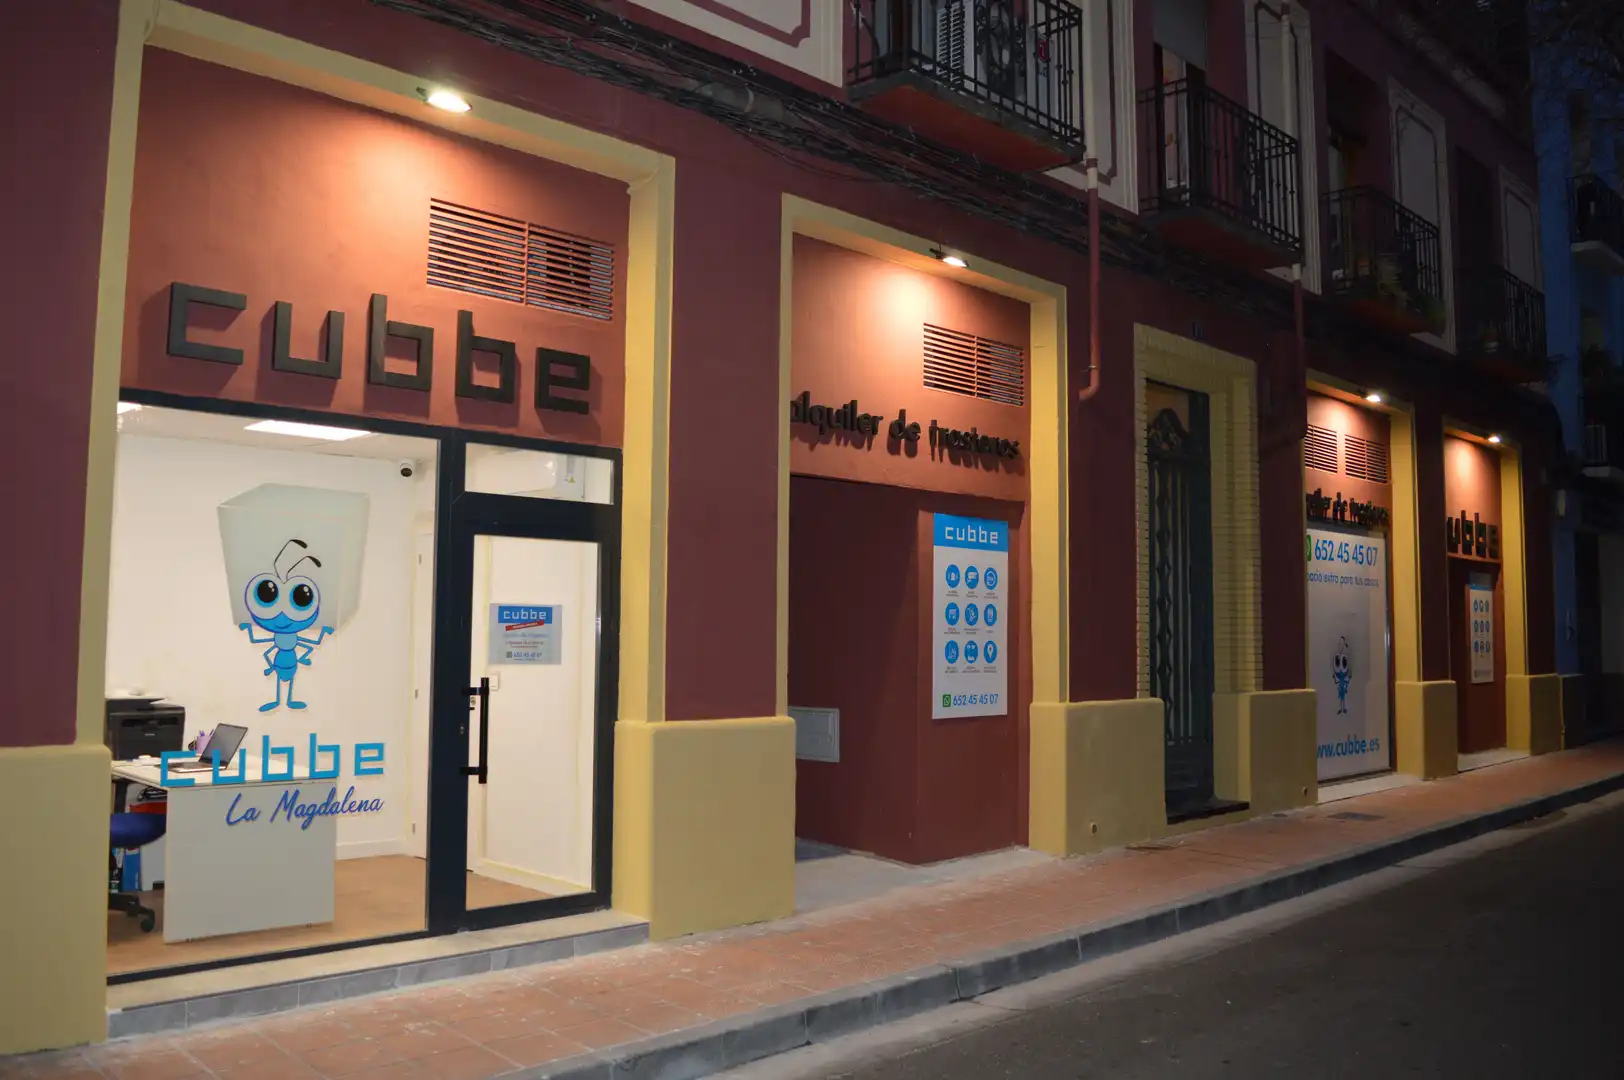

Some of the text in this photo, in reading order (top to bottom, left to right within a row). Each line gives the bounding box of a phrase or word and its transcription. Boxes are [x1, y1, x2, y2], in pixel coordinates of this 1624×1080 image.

[166, 281, 591, 414] cubbe
[790, 390, 1020, 459] alquiler de trasteros
[945, 525, 998, 544] cubbe
[1447, 509, 1499, 551] ubbe
[1315, 539, 1378, 566] 652 45 45 07
[503, 608, 547, 620] cubbe
[953, 693, 998, 706] 652 45 45 07
[160, 732, 385, 787] cubbe
[1316, 734, 1380, 759] ww.cubbe.es
[225, 785, 384, 830] La Magdalena
